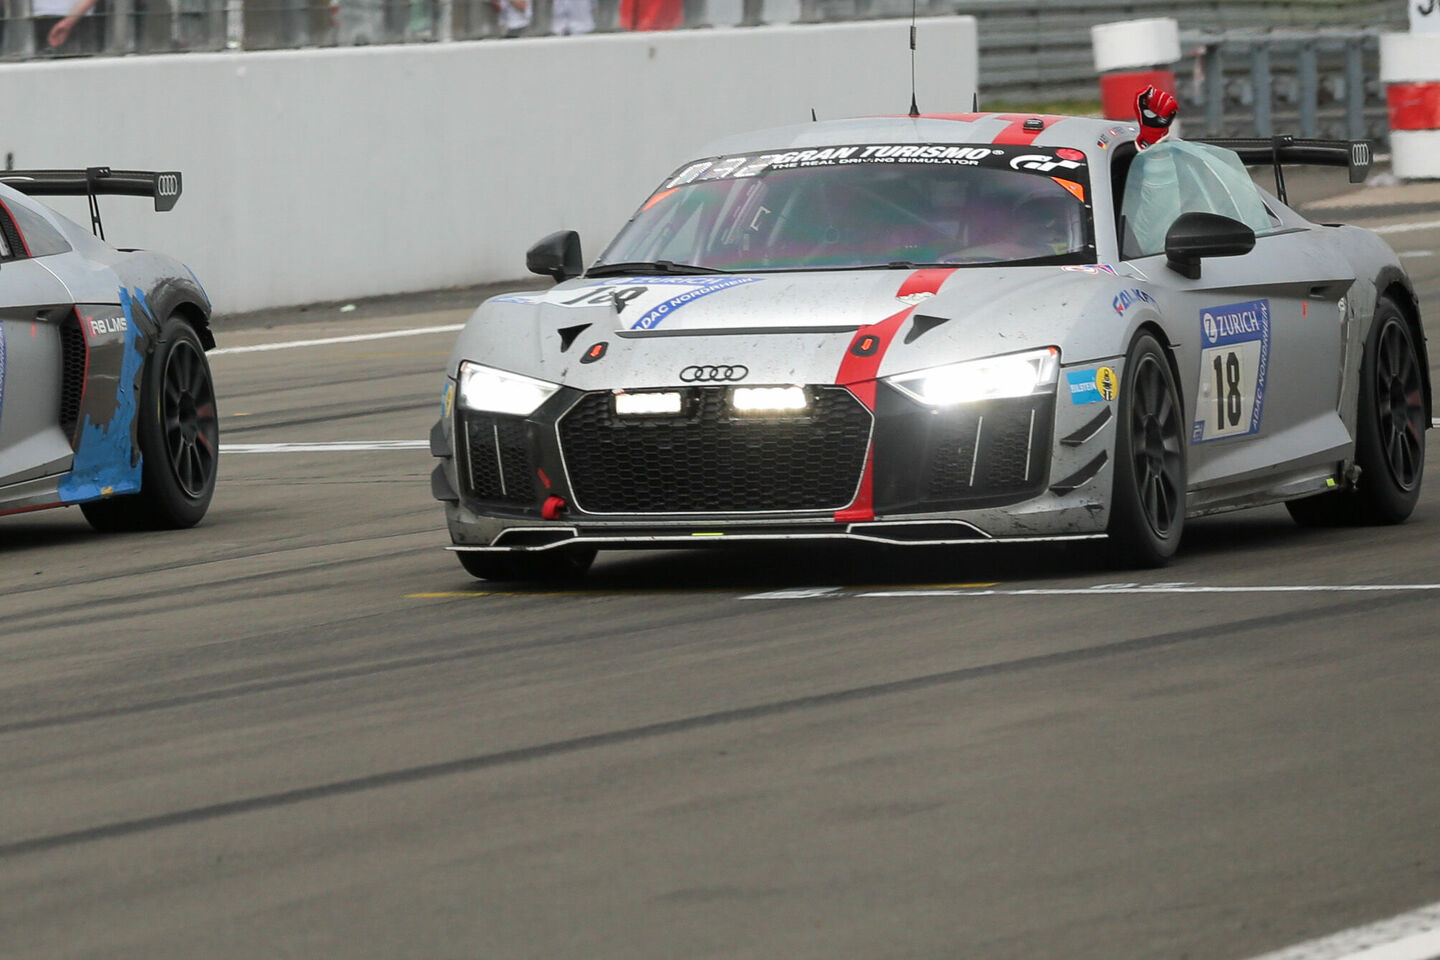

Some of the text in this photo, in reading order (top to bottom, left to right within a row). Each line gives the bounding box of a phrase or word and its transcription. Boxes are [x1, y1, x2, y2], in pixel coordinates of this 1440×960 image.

[772, 145, 991, 163] GRAN TURISMO
[898, 157, 979, 166] SIMULATOR
[669, 277, 754, 308] NORDRHEIN
[1217, 310, 1260, 337] ZURICH
[1251, 302, 1269, 431] ADAC NORDRHEIN
[1213, 351, 1242, 430] 18
